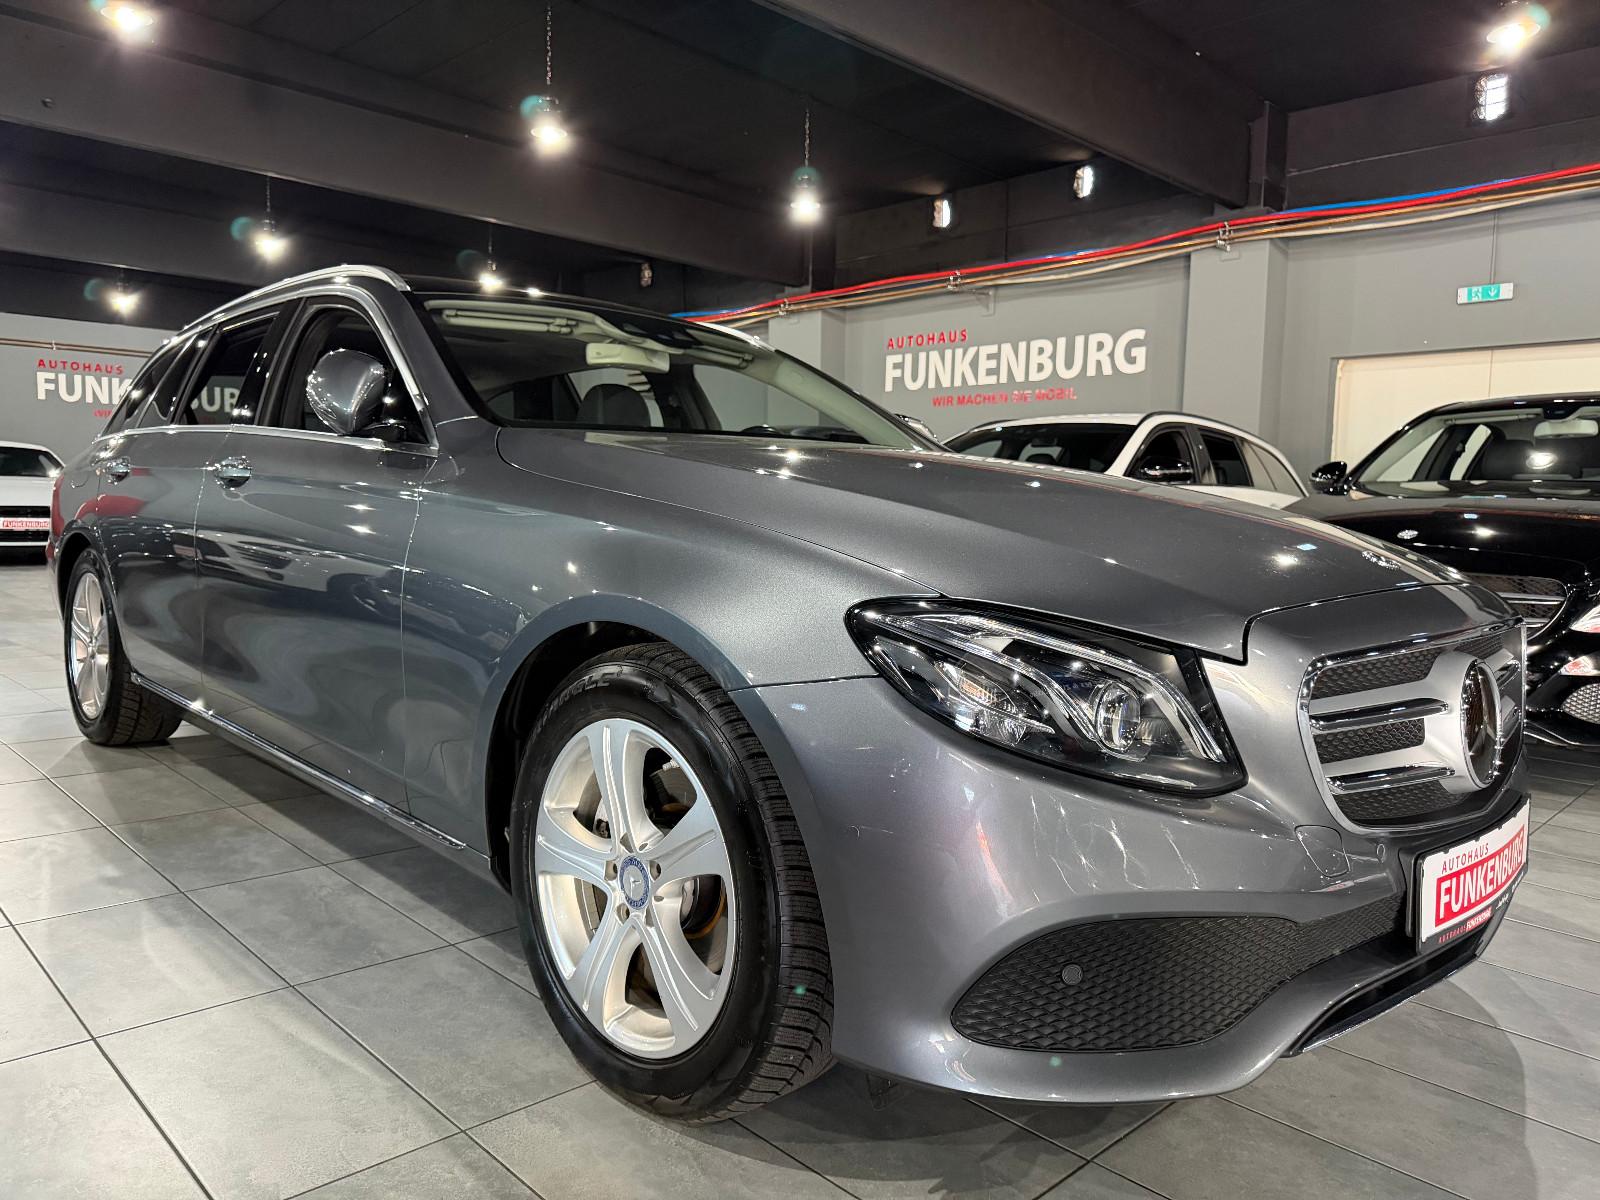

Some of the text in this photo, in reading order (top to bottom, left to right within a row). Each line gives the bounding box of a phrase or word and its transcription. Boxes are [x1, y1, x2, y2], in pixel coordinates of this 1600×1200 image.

[887, 328, 968, 350] AUTOHAUS
[38, 359, 124, 375] AUTOHAUS
[884, 328, 1147, 393] FUNKENBURG
[932, 387, 1078, 407] WIR MACHEN SIE MOBIL
[3, 520, 49, 529] FUNKENBURG
[1441, 843, 1489, 875] AUTOHAUS
[1439, 832, 1525, 920] FUNKENBURG
